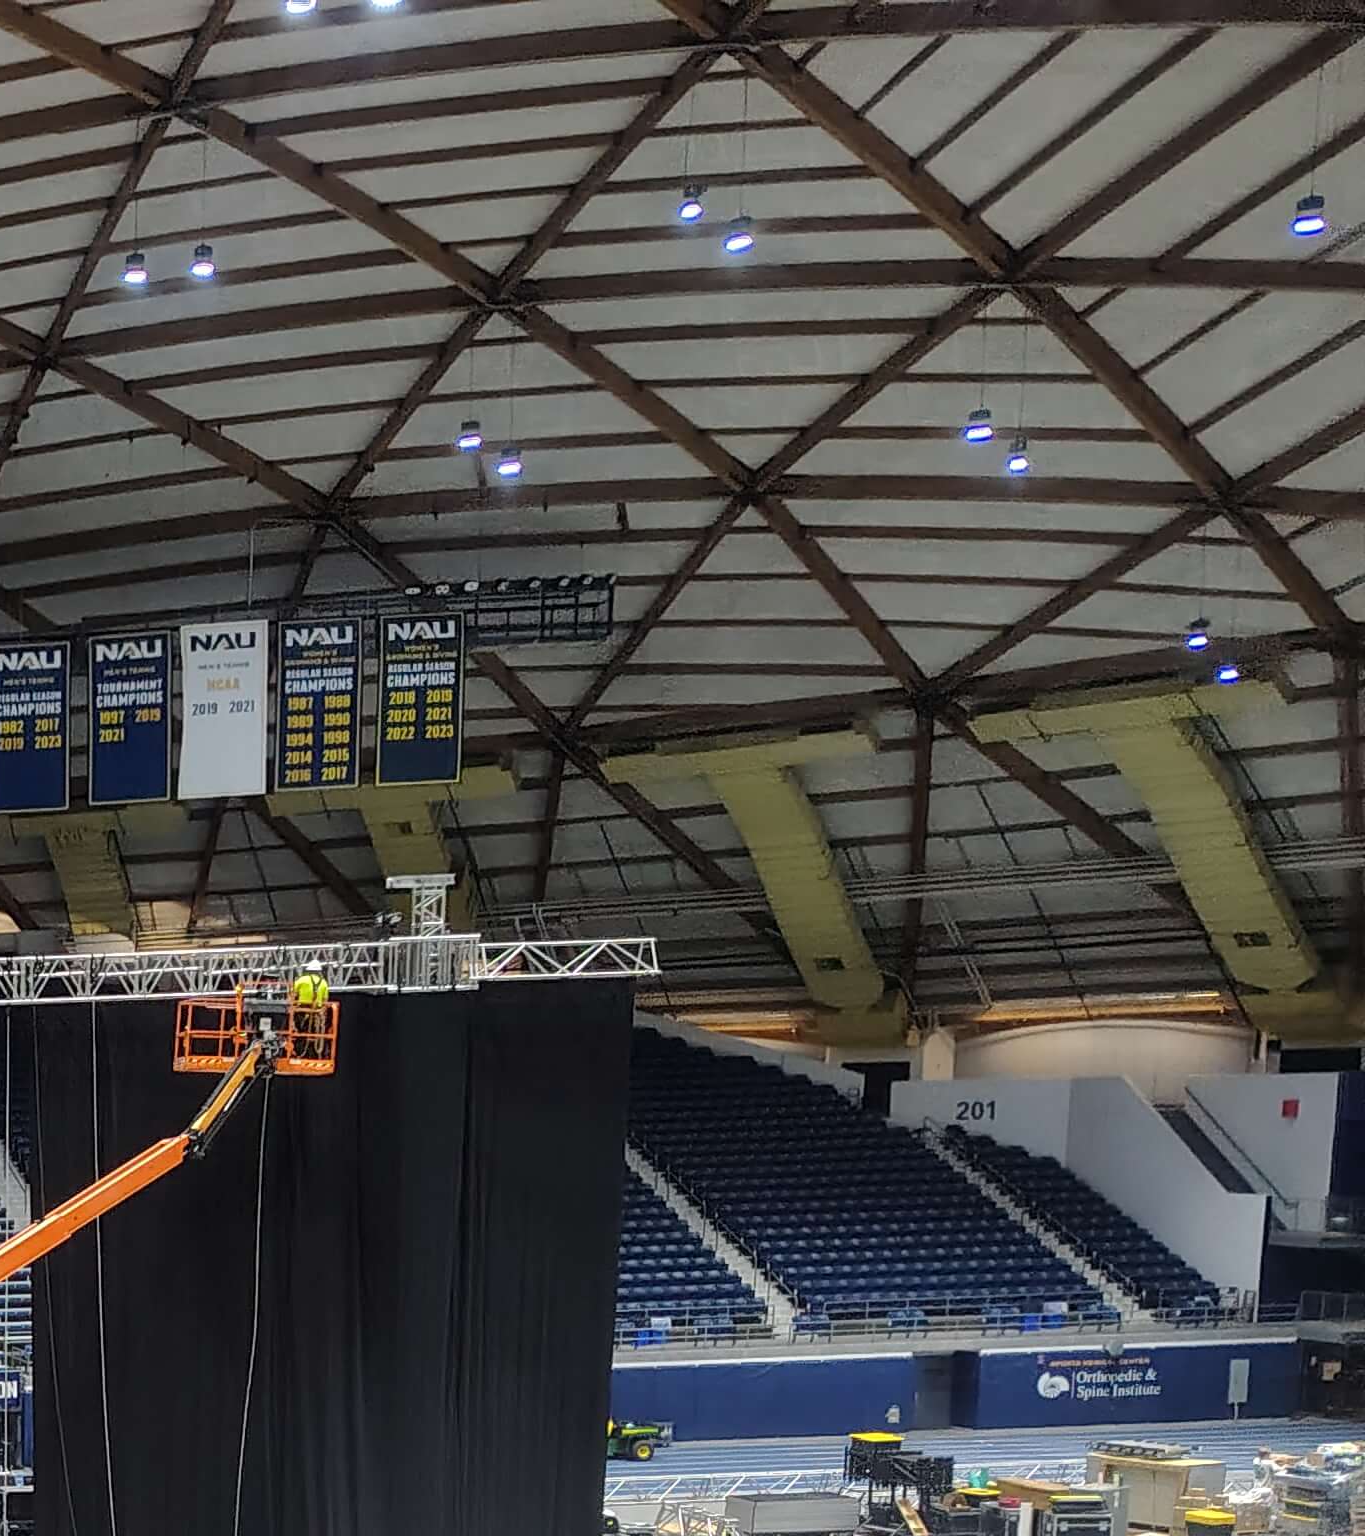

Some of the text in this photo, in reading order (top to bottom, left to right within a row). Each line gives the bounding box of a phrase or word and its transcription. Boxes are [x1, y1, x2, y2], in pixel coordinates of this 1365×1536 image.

[285, 626, 353, 647] NAU
[388, 621, 455, 641] NAU
[190, 633, 256, 652] NAU
[96, 640, 162, 662] NAU
[96, 679, 163, 693] TOURNAMENT
[285, 678, 353, 694] CHAMPIONS
[387, 672, 455, 687] CHAMPIONS
[33, 691, 61, 700] SEASON
[96, 692, 163, 708] CHAMPIONS
[192, 701, 255, 716] 2019 2021
[387, 707, 451, 722] 2020 2021
[35, 719, 59, 732] 2017
[386, 725, 453, 740] 2022 2023
[35, 736, 61, 749] 2023
[99, 729, 124, 743] 2021
[285, 751, 312, 764] 2014
[321, 767, 347, 781] 2017
[956, 1101, 997, 1121] 201
[1077, 1368, 1157, 1385] Orthopedic &
[1076, 1384, 1161, 1401] Spine Institute
